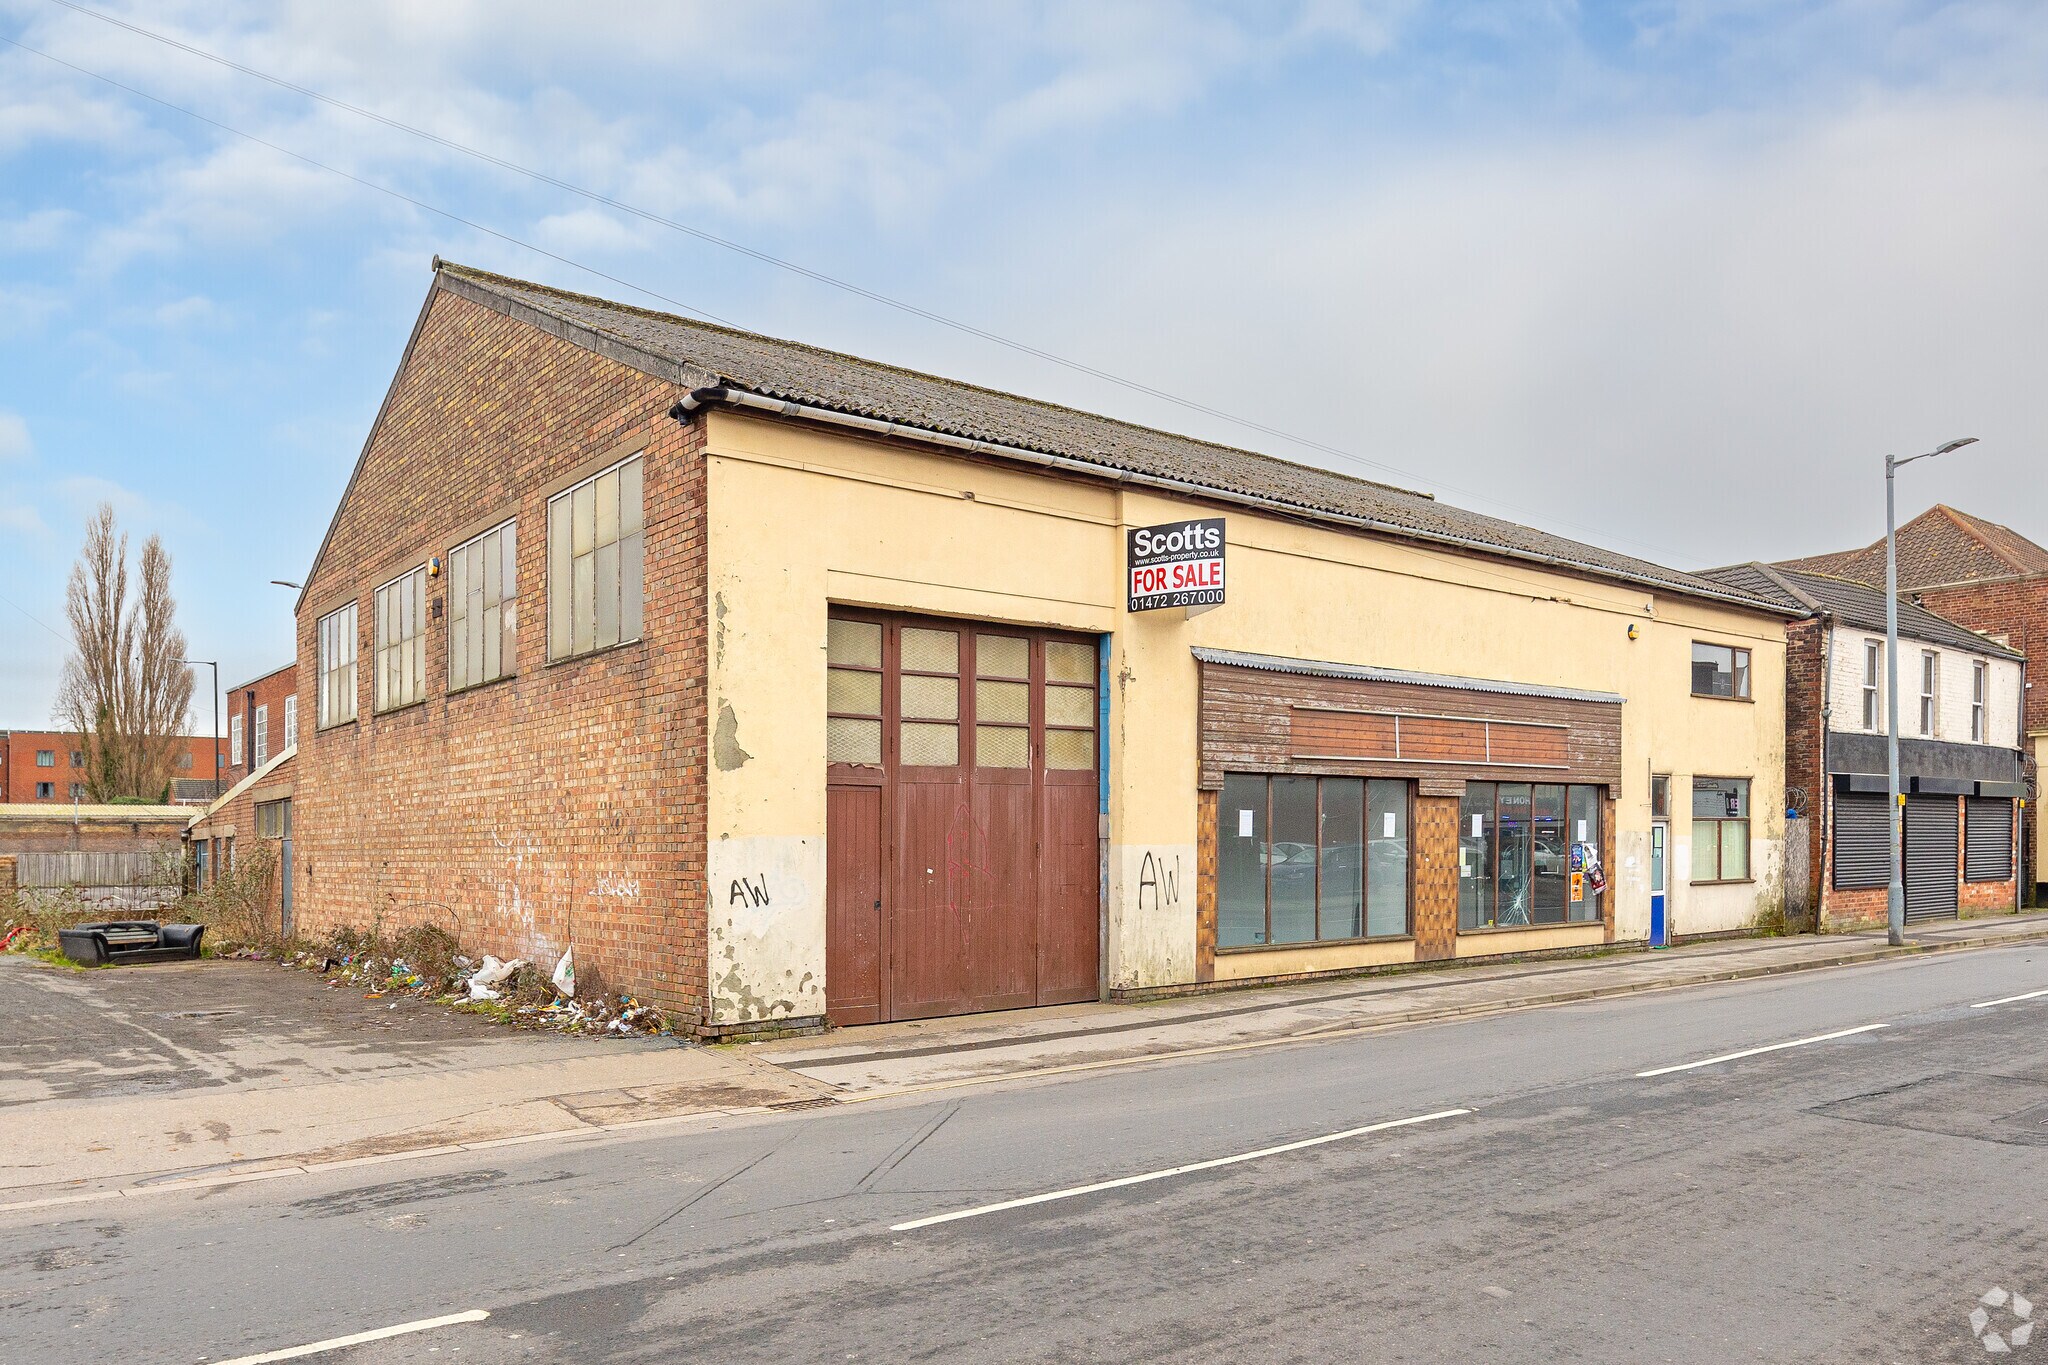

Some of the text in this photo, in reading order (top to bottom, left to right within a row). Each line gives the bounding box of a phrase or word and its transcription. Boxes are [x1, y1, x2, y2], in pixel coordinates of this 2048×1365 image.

[1134, 523, 1220, 557] Scotts
[1135, 549, 1219, 566] www.scotts-property.co.uk
[1134, 562, 1221, 594] FOR SALE
[1131, 590, 1224, 611] 01472 267000
[730, 873, 770, 908] AW
[1138, 850, 1180, 910] AW
